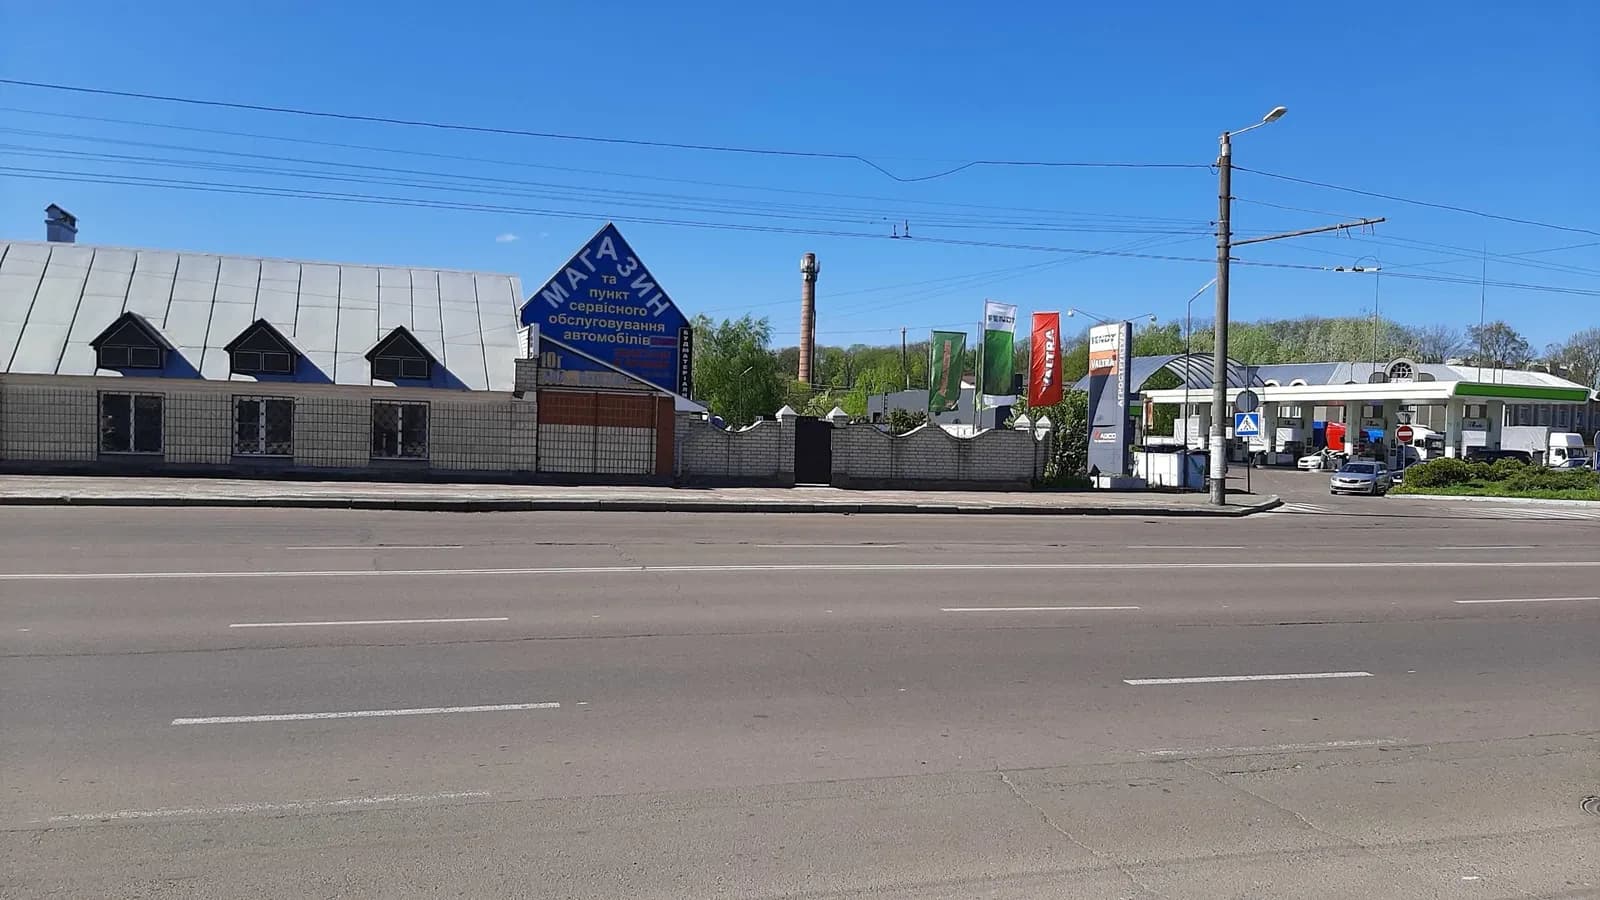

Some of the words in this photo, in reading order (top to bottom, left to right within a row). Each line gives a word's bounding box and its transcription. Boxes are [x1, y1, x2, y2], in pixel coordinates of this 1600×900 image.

[542, 236, 670, 317] МАГАЗИН
[602, 274, 617, 285] та
[589, 288, 630, 301] пункт
[569, 301, 648, 316] сервісного
[548, 314, 665, 332] обслуговування
[563, 330, 650, 346] автомобілів
